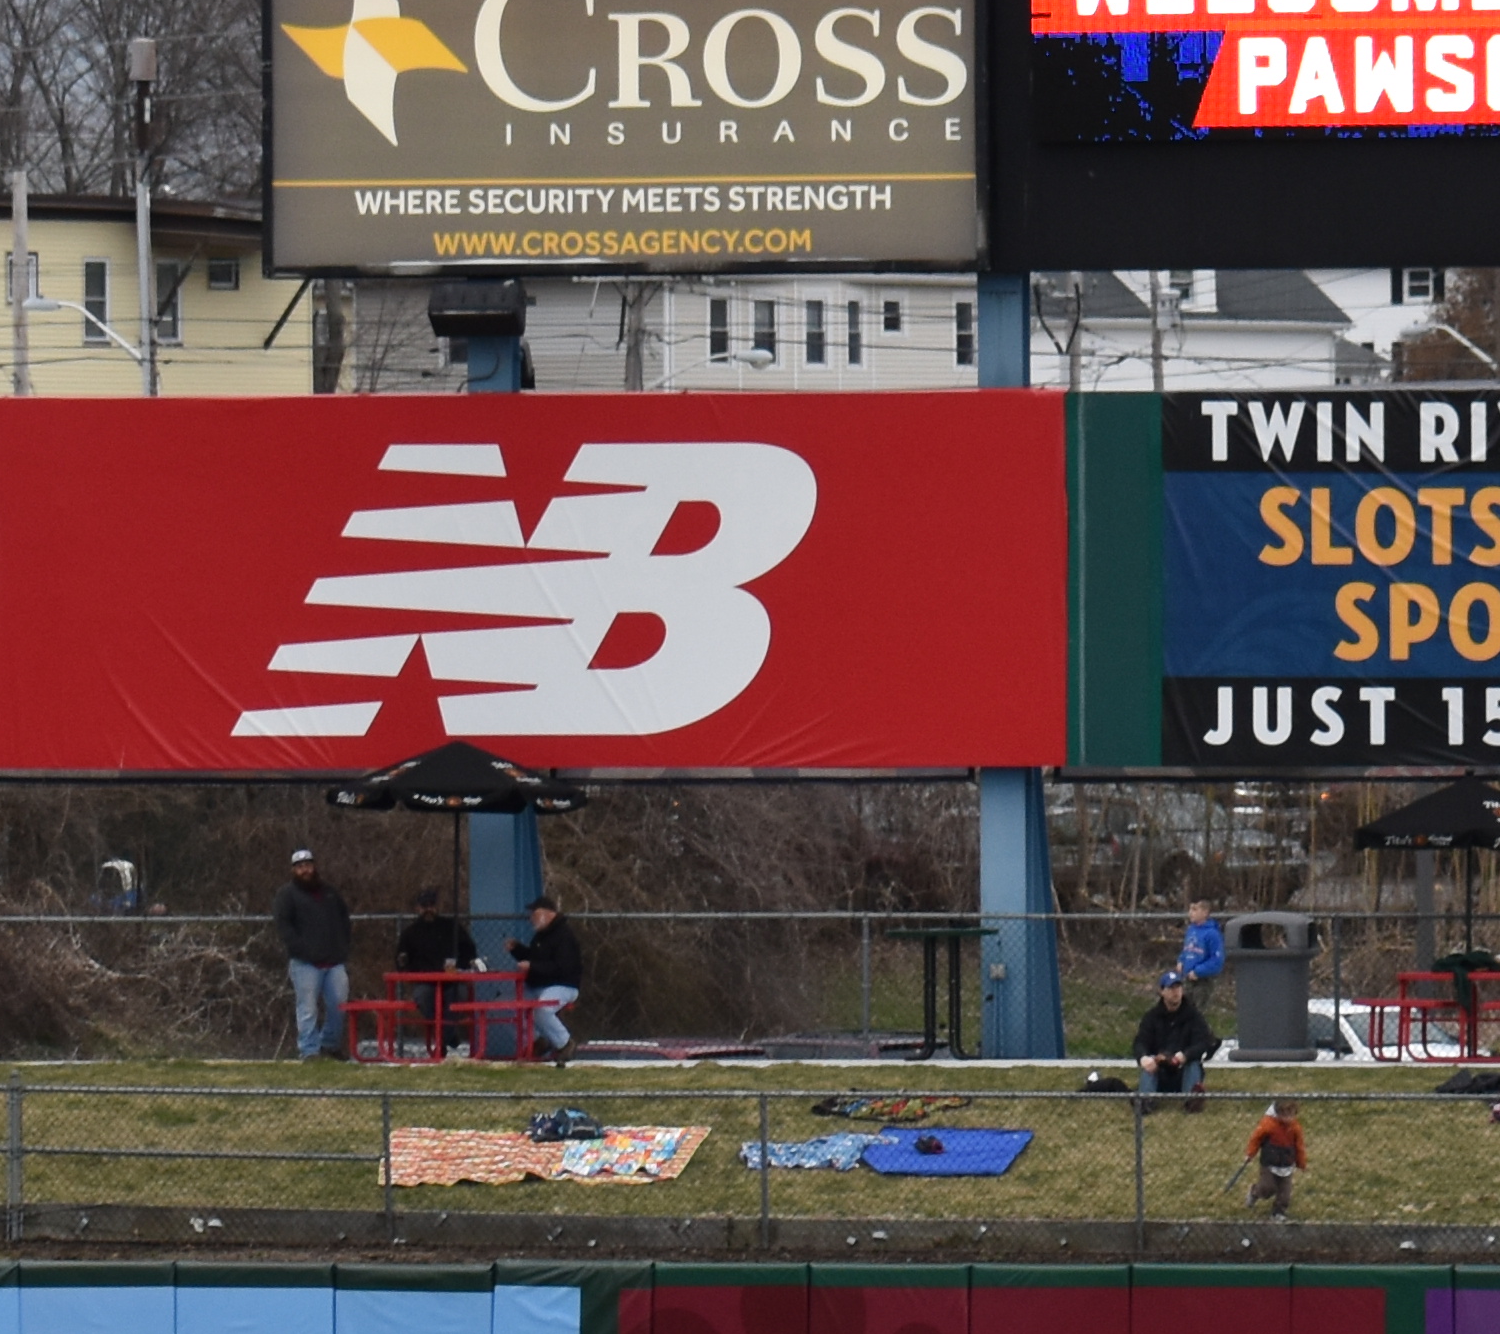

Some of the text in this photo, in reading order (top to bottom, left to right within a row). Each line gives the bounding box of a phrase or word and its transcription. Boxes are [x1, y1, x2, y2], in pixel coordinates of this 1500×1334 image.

[505, 118, 962, 145] INSURANCE
[354, 184, 892, 215] WHERE SECURITY MEETS STRENGTH
[433, 229, 811, 255] WWW.CROSSAGENCY.COM
[1201, 400, 1384, 462] TWIN
[1202, 686, 1397, 747] JUST
